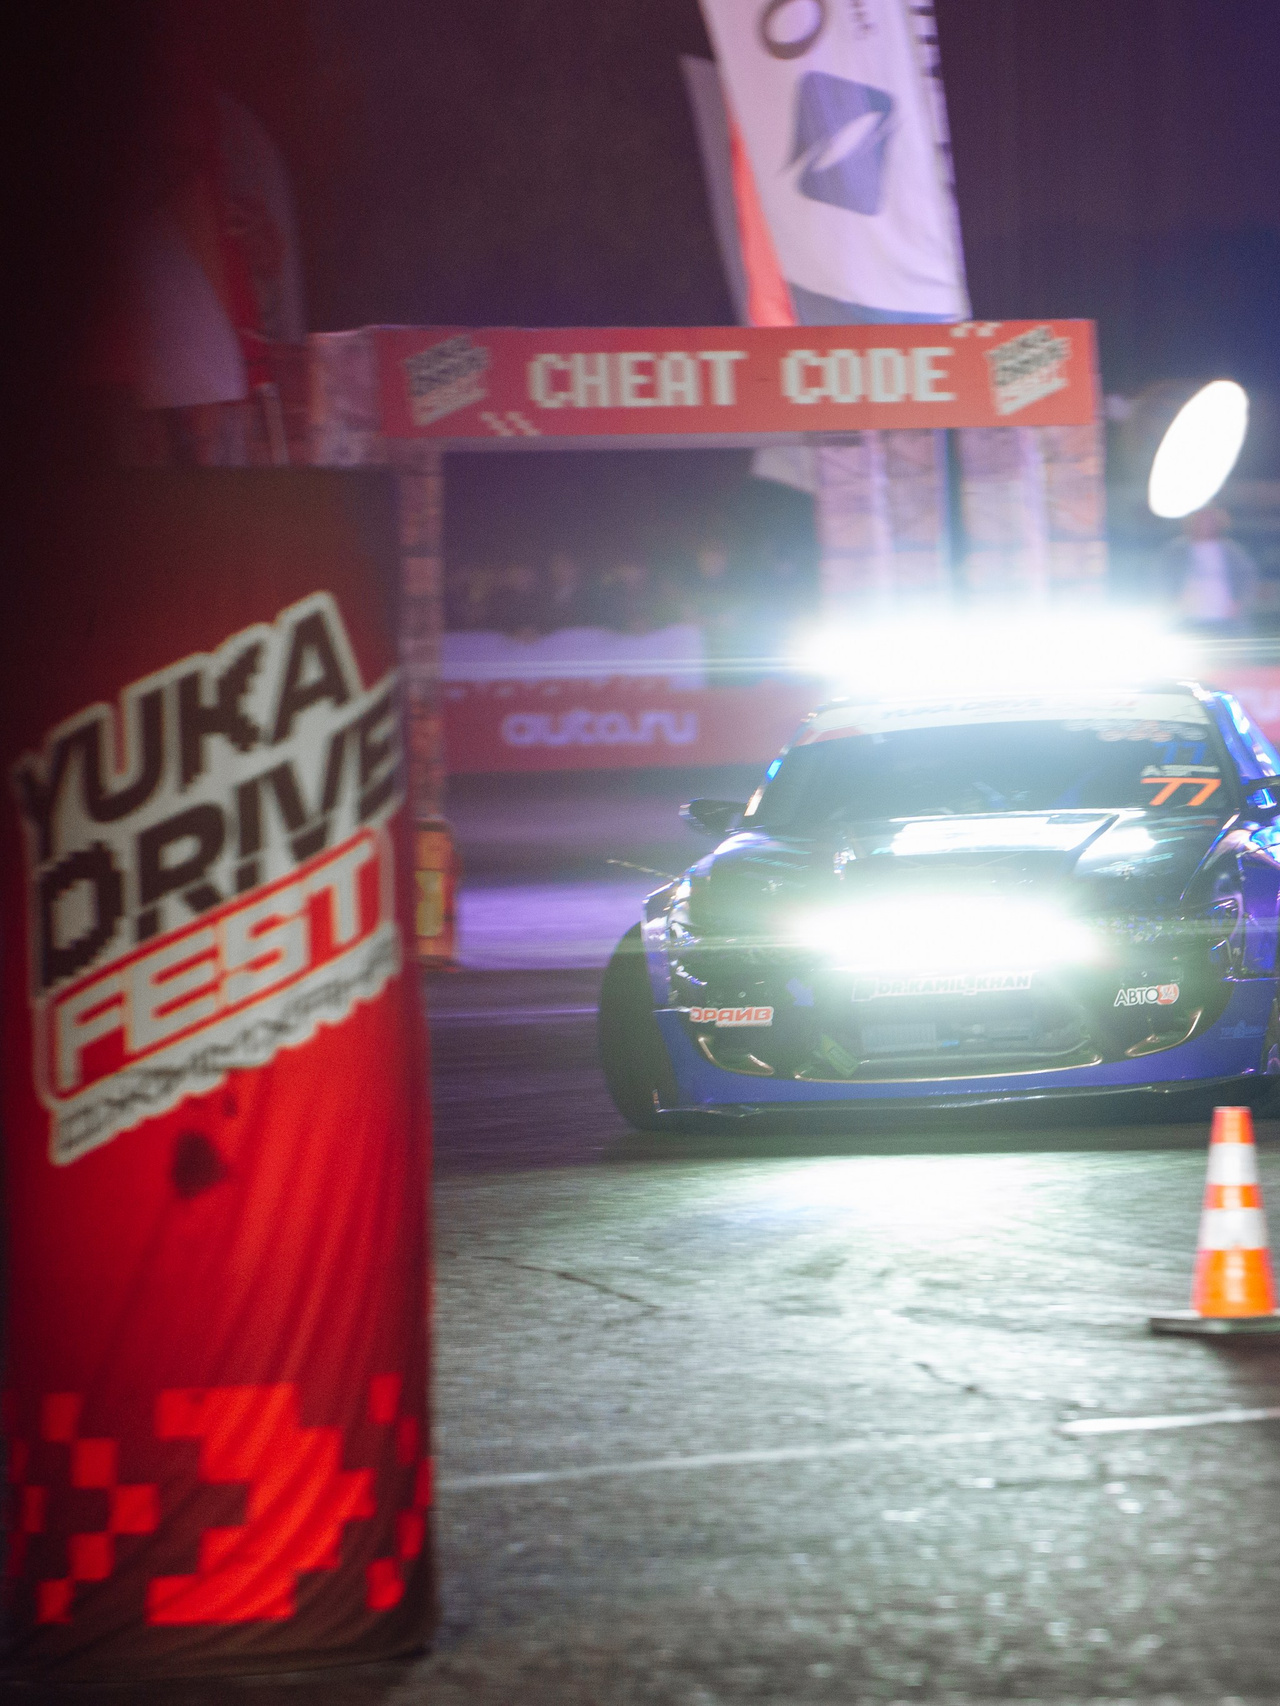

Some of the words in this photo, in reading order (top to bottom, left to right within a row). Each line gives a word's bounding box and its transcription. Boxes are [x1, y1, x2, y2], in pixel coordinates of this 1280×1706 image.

[527, 350, 747, 407] CHEAT
[780, 345, 957, 404] CODE
[14, 600, 354, 862] YUKA
[36, 686, 404, 989] DRIVE
[1140, 777, 1222, 807] 77
[54, 836, 378, 1090] FEST
